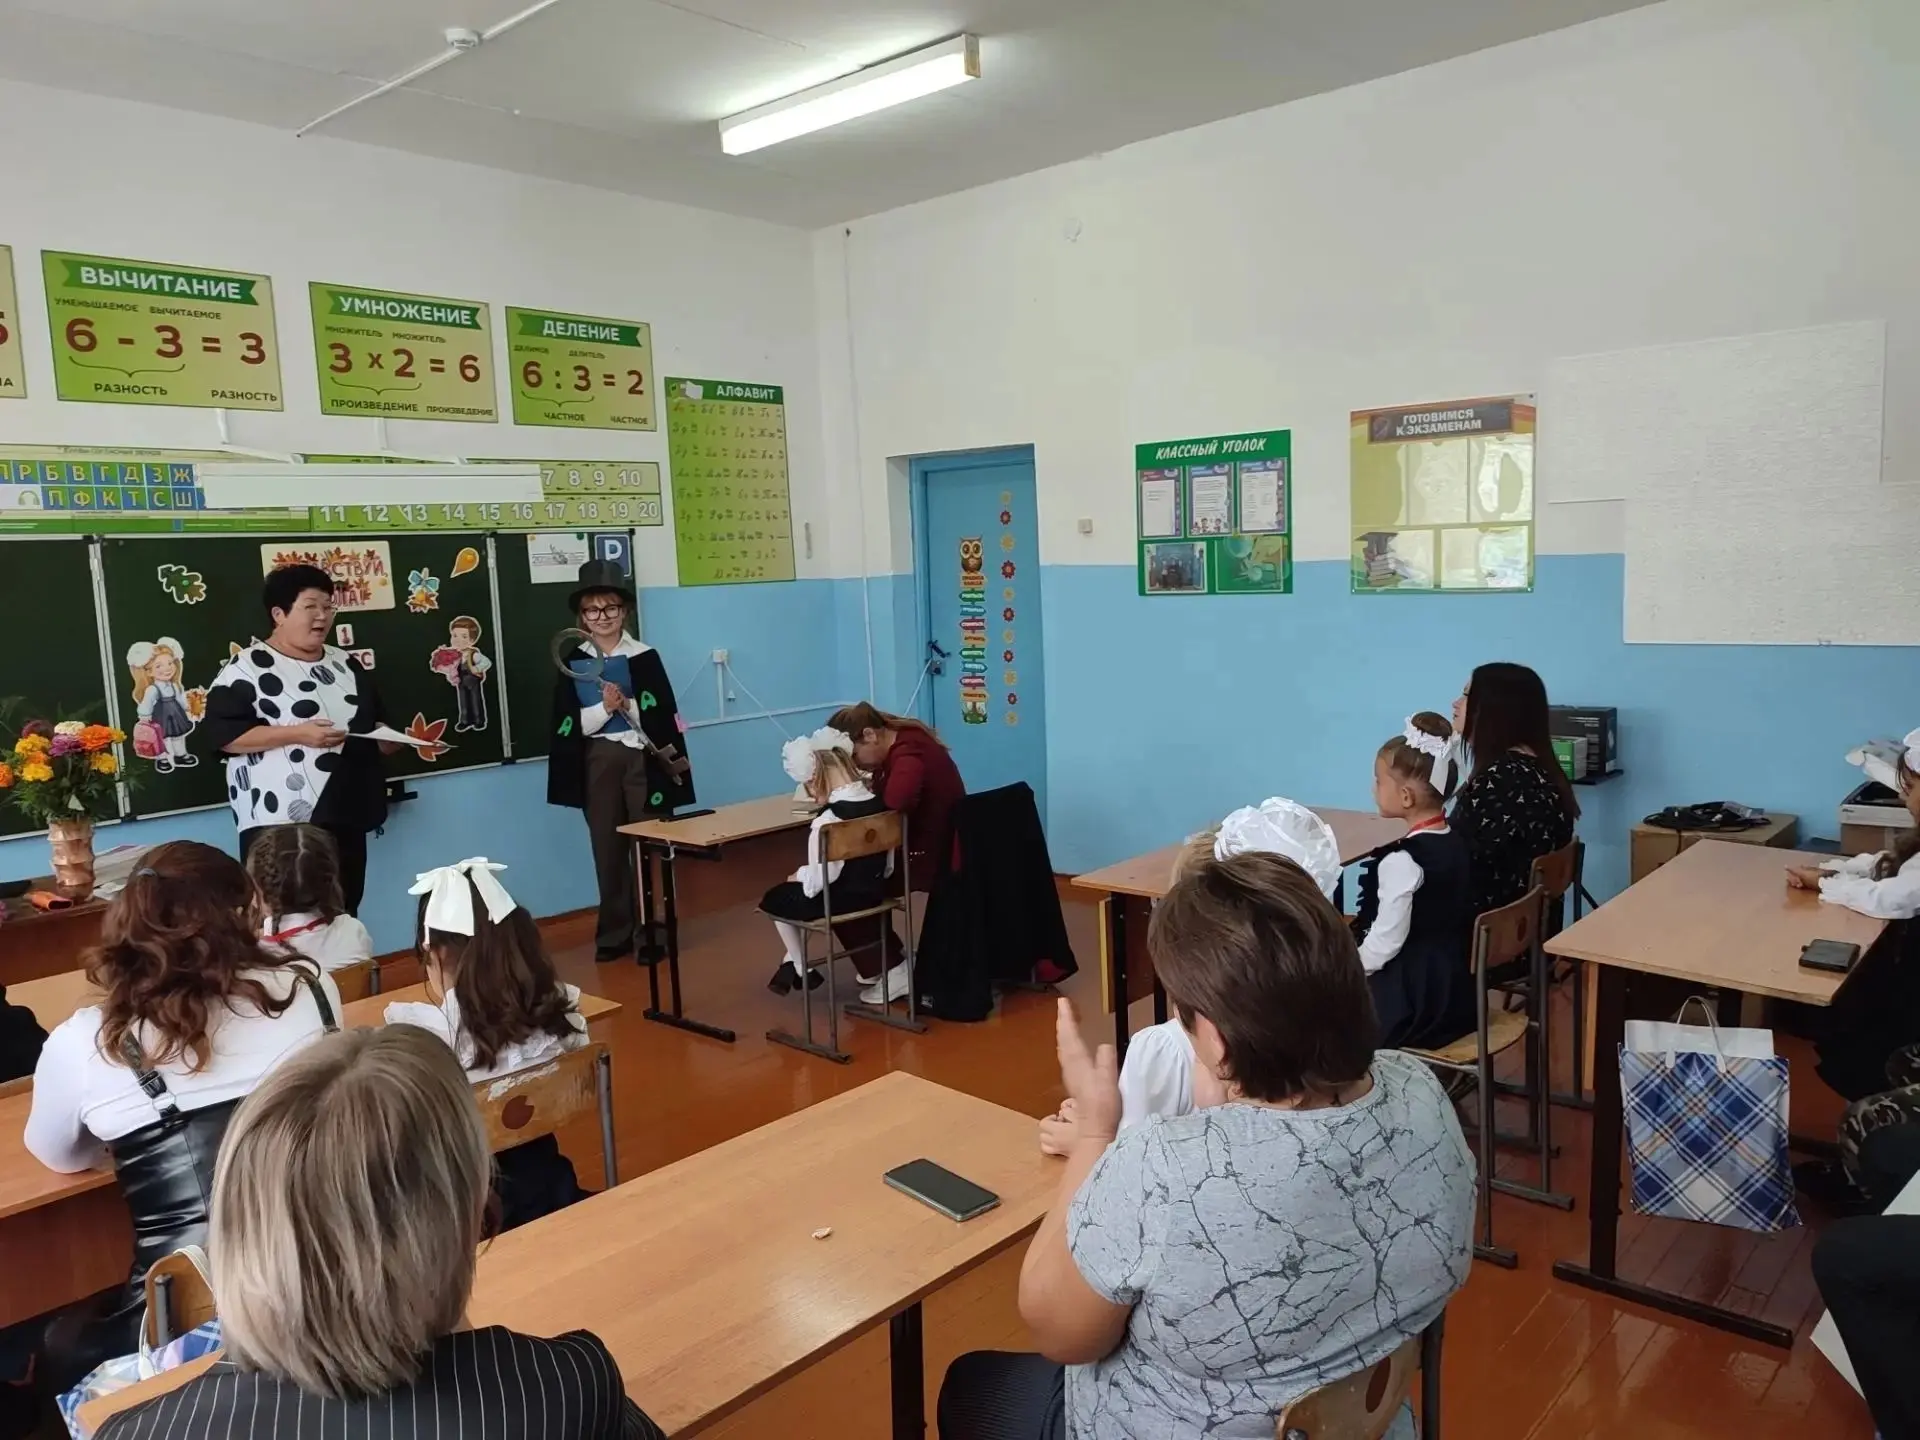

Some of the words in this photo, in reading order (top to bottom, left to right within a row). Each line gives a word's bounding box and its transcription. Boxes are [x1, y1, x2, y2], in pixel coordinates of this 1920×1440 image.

[80, 266, 242, 299] ВЫЧИТАНИЕ
[54, 297, 138, 312] УМЕНЬШАЕМОЕ
[150, 306, 222, 320] ВЫЧИТАЕМОЕ
[339, 296, 473, 325] УМНОЖЕНИЕ
[542, 319, 621, 341] ДЕЛЕНИЕ
[65, 317, 97, 353] 6
[154, 324, 183, 359] 3
[238, 332, 266, 365] 3
[328, 342, 353, 374] 3
[392, 348, 416, 378] 2
[459, 354, 481, 383] 6
[522, 360, 543, 388] 6
[573, 365, 592, 392] 3
[626, 369, 645, 395] 2
[94, 382, 168, 396] РАЗНОСТЬ
[211, 389, 277, 402] РАЗНОСТЬ
[716, 384, 776, 400] АЛФАВИТ
[330, 398, 419, 412] ПРОИЗВЕДЕНИЕ
[426, 405, 494, 416] ПРОИЗВЕДЕНИЕ
[1403, 408, 1474, 425] ГОТОВИМСЯ
[543, 411, 586, 422] ЧАСТНОЕ
[610, 415, 649, 425] ЧАСТНОЕ
[1396, 426, 1405, 436] К
[1406, 419, 1482, 436] ЭКЗАМЕНАМ
[1155, 439, 1219, 460] КЛАССНЫЙ
[1221, 437, 1267, 454] УГОЛОК
[19, 464, 32, 481] Р
[45, 465, 60, 481] Б
[72, 465, 86, 482] В
[100, 465, 110, 482] Г
[124, 466, 140, 483] Д
[152, 467, 163, 483] З
[173, 468, 192, 483] Ж
[542, 469, 555, 486] 7
[568, 469, 581, 487] 8
[593, 469, 606, 486] 9
[619, 469, 641, 487] 10
[48, 490, 64, 507] П
[73, 490, 91, 507] Ф
[102, 491, 117, 507] К
[127, 490, 140, 507] Т
[153, 491, 166, 507] С
[175, 491, 193, 508] Ш
[320, 504, 346, 522] 11
[362, 504, 389, 522] 12
[402, 503, 428, 522] 13
[442, 503, 466, 521] 14
[478, 503, 500, 520] 15
[512, 503, 533, 520] 16
[544, 502, 566, 519] 17
[577, 502, 598, 519] 18
[608, 501, 629, 518] 19
[638, 501, 658, 518] 20
[340, 626, 351, 644] 1
